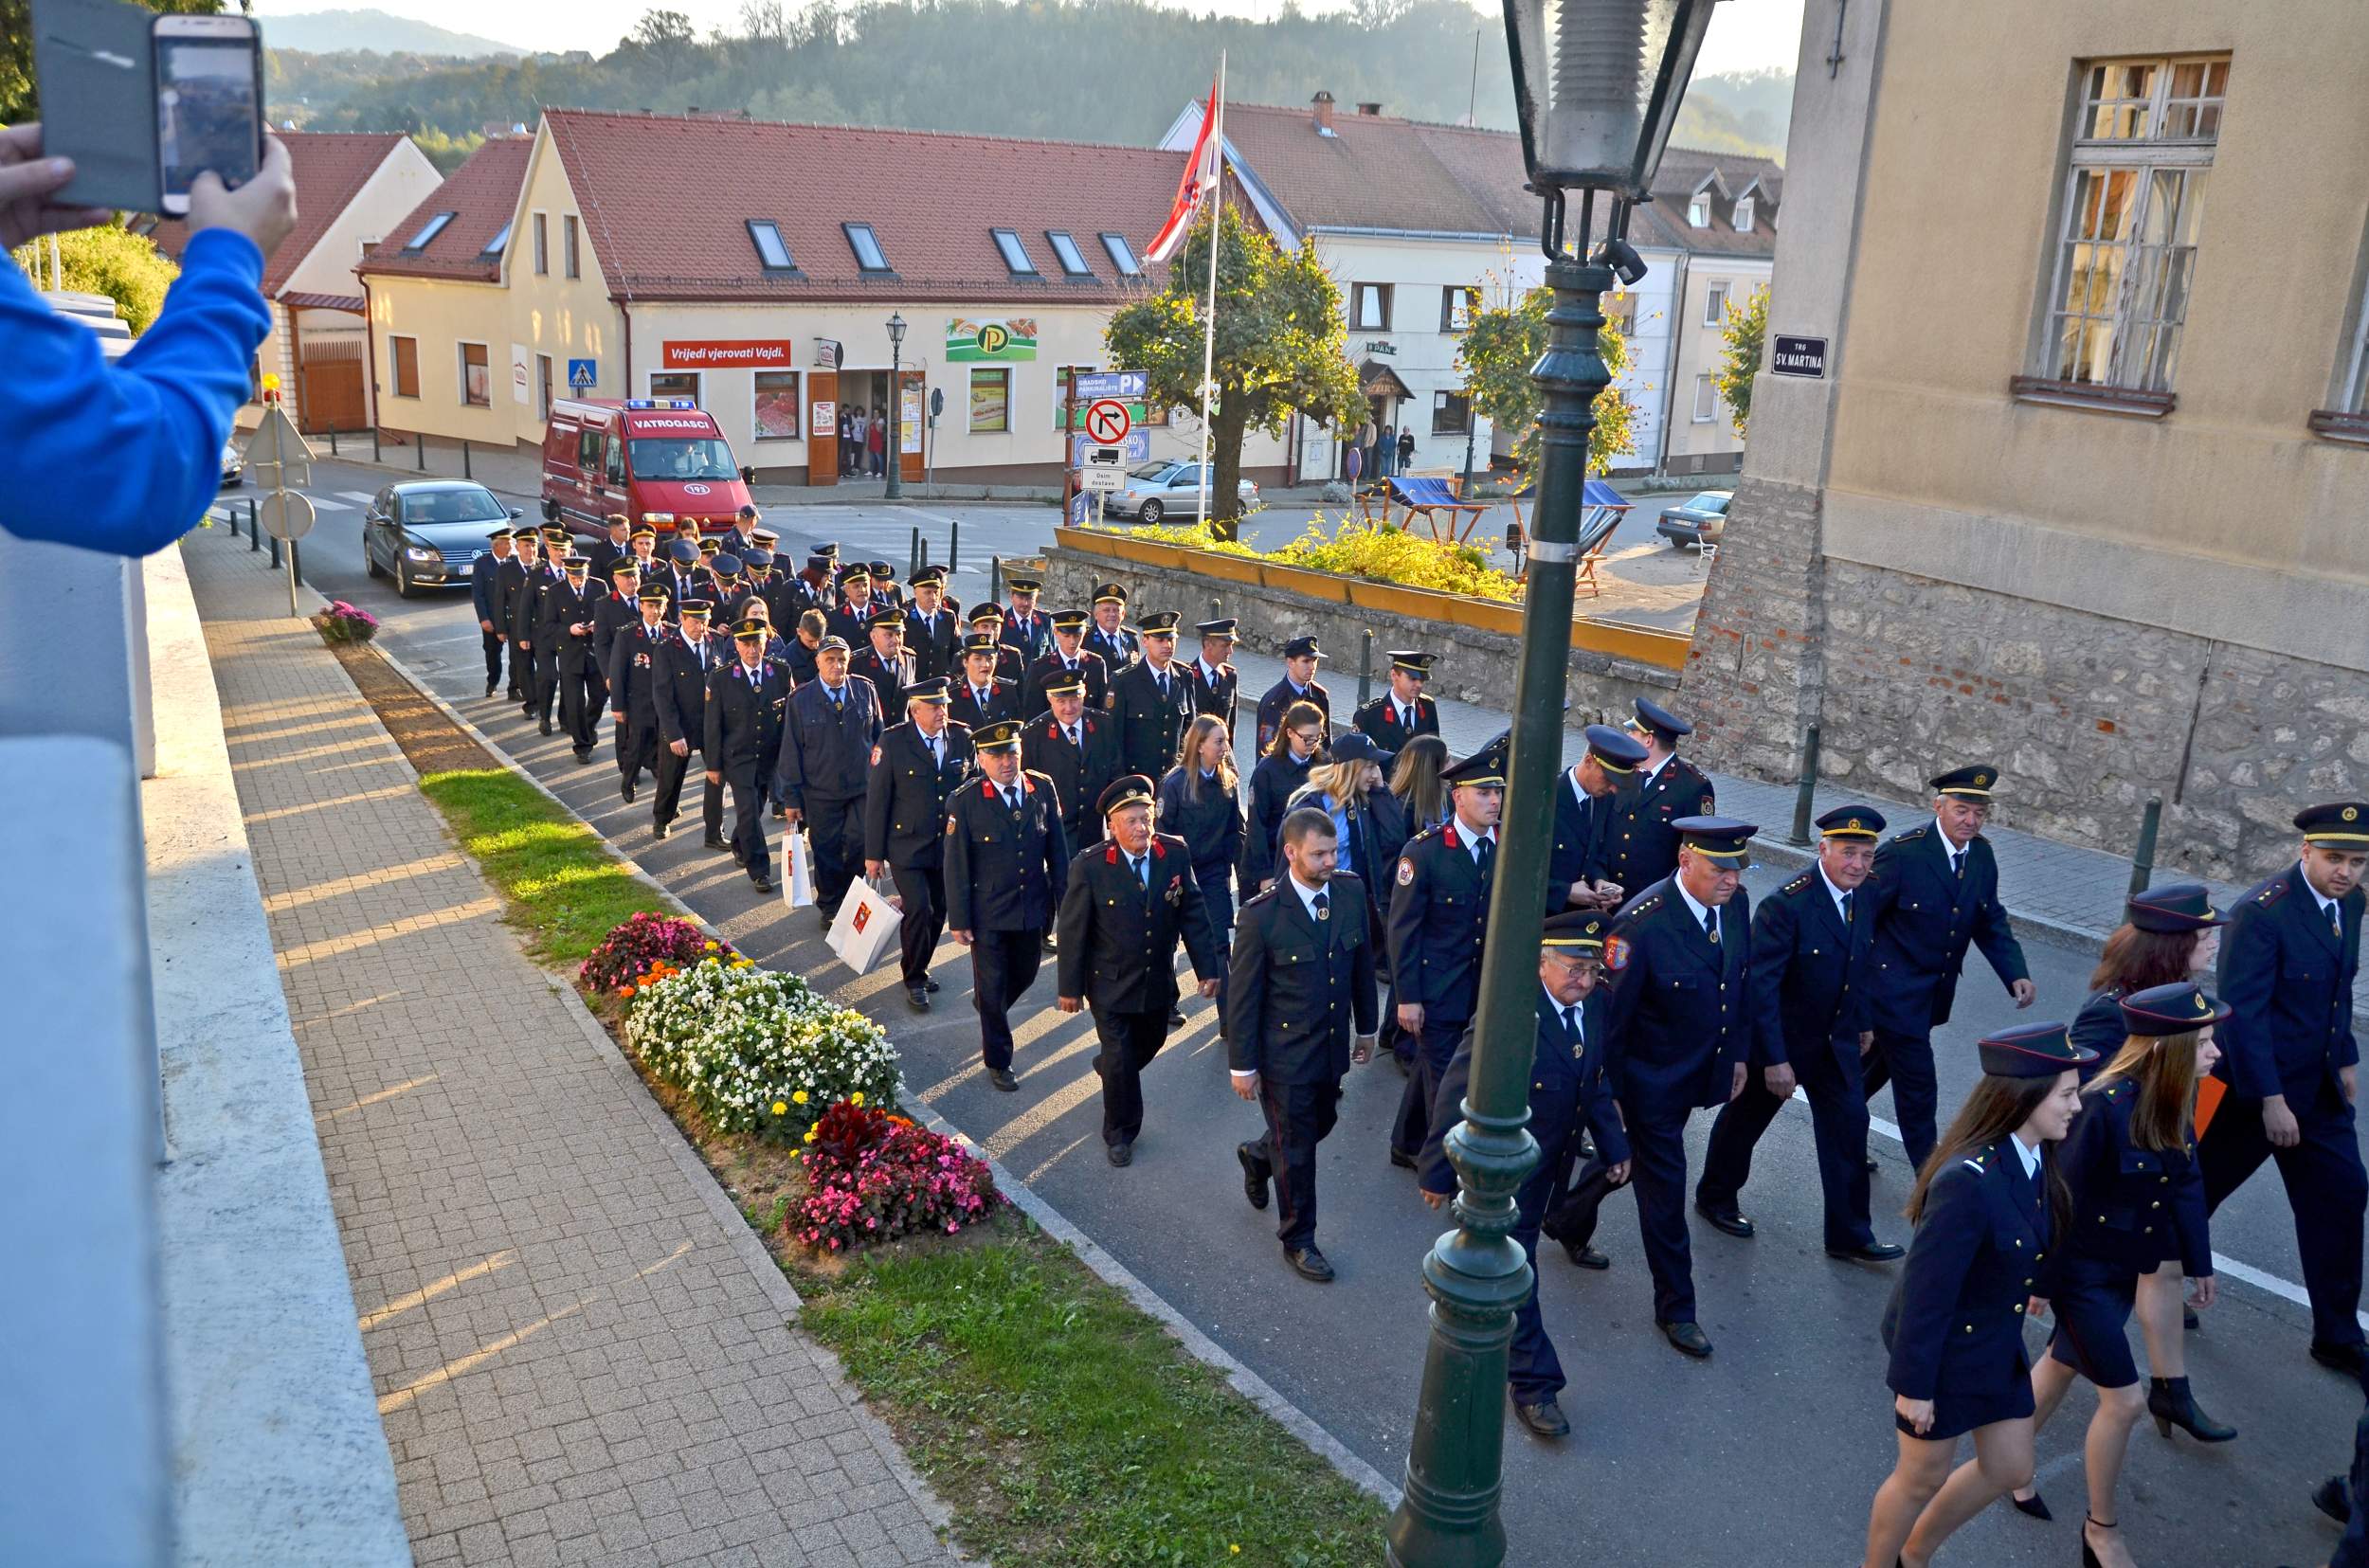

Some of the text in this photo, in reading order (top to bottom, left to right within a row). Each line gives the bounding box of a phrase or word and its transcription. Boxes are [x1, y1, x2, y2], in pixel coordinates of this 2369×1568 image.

[671, 346, 785, 362] Vrijedi vjerovati Vajdi.
[1795, 342, 1807, 351] TRG
[1775, 352, 1822, 369] SV. MARTINA
[1120, 375, 1131, 393] P
[634, 419, 710, 430] VATROGASCI
